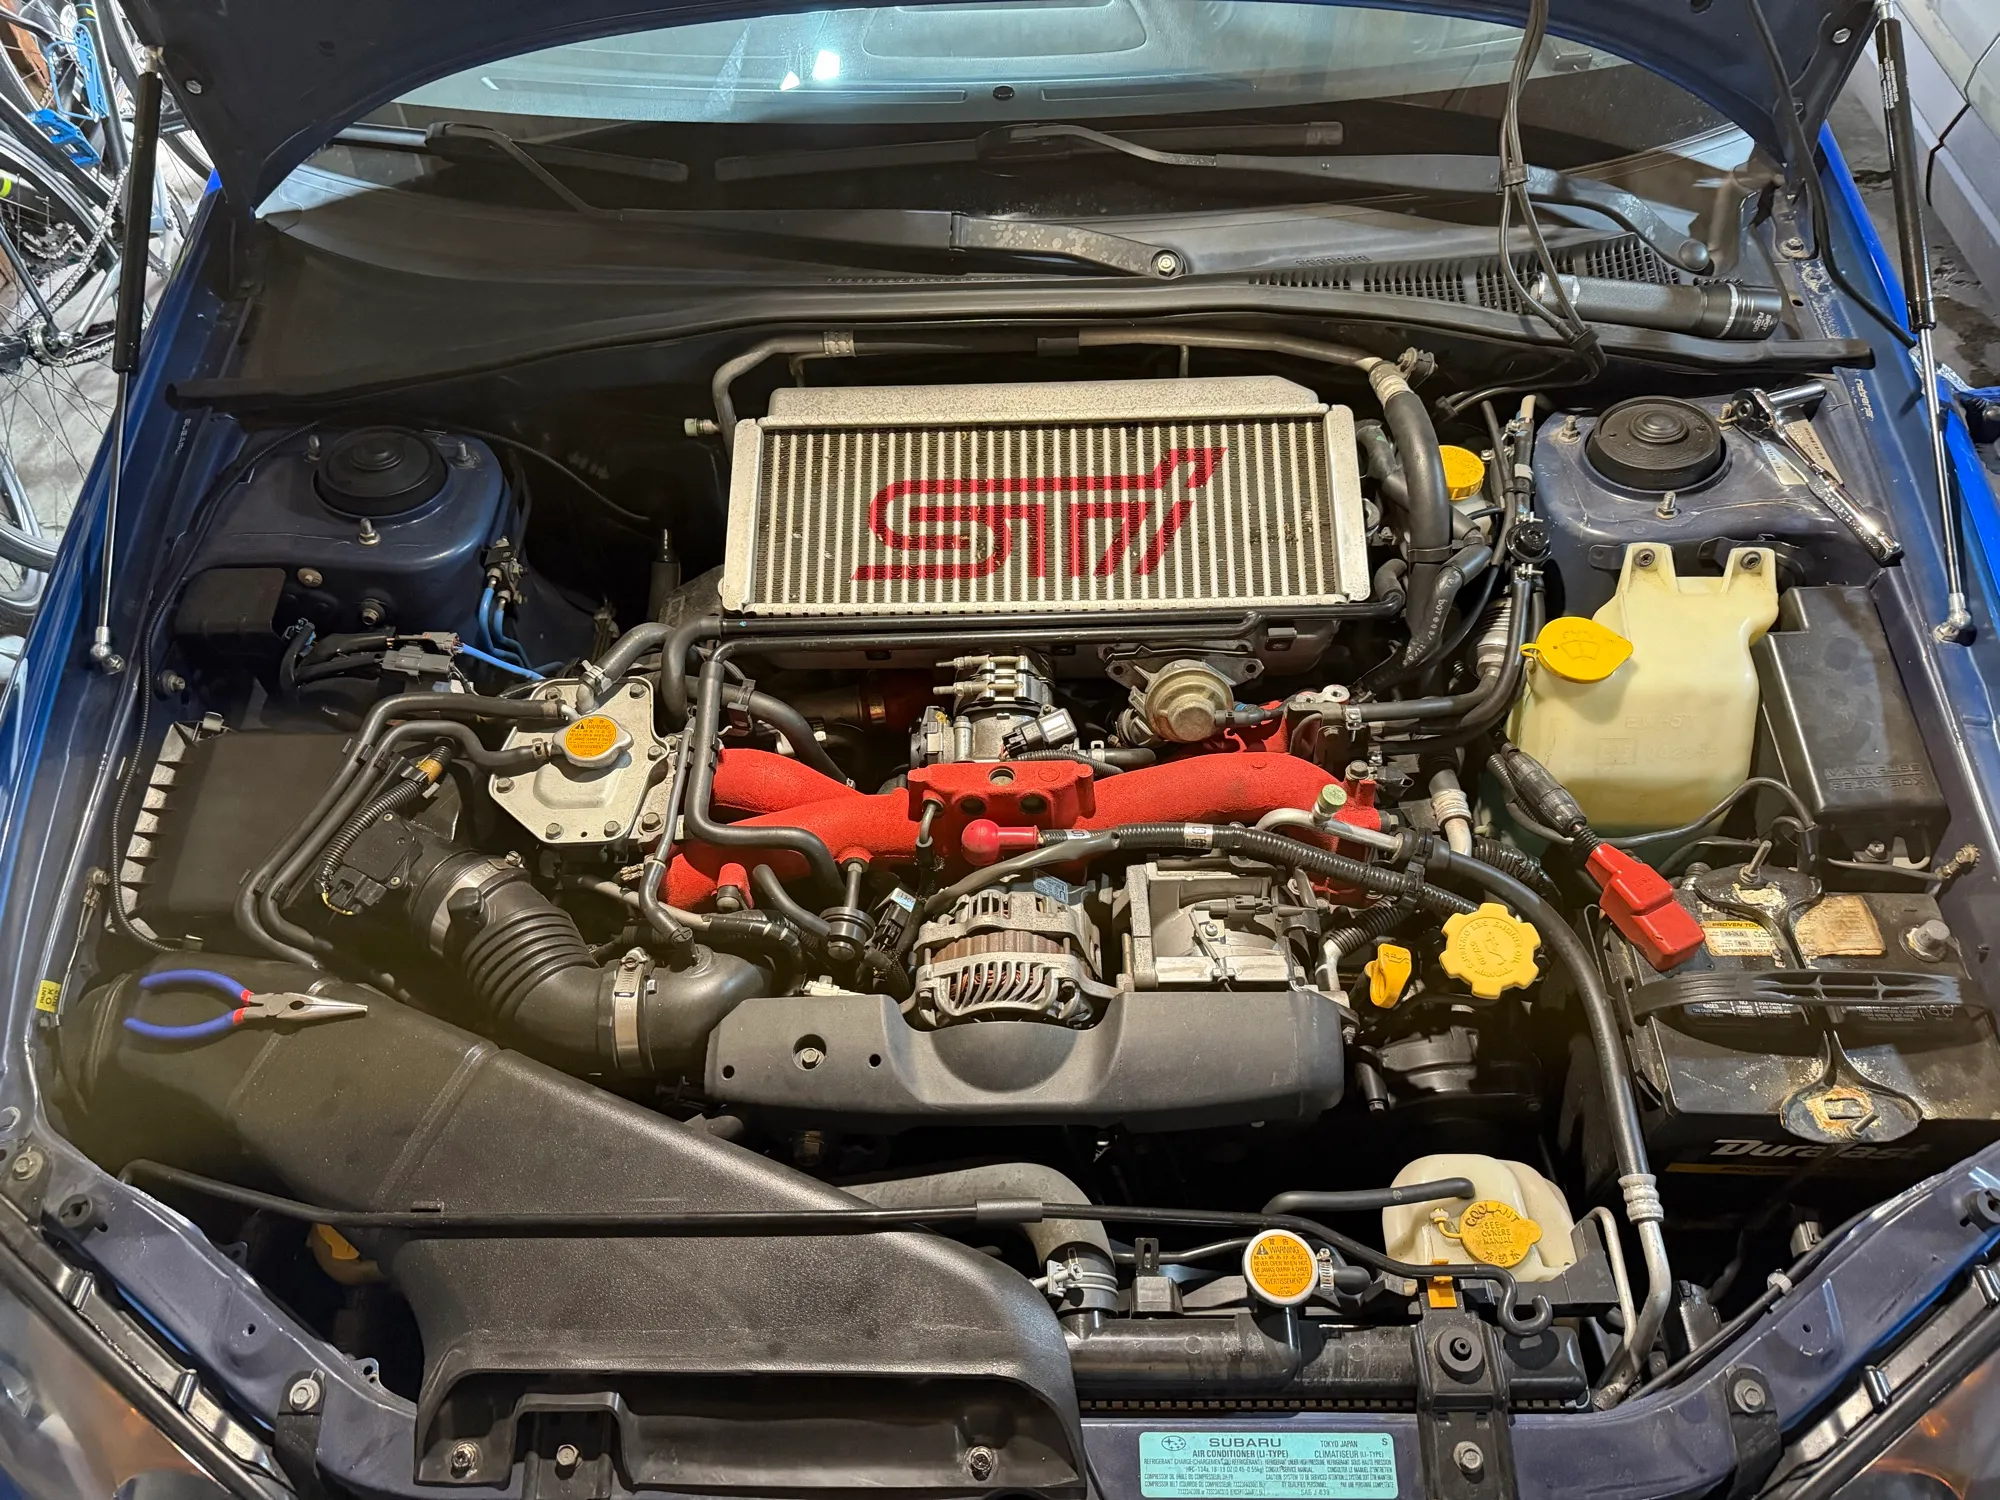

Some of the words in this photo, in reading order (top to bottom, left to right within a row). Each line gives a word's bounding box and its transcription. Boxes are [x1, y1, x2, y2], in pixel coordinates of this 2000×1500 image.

[851, 447, 1227, 581] STI
[1824, 766, 1873, 777] MAIN
[1829, 779, 1882, 790] RELAY
[1889, 777, 1926, 787] BOX
[1465, 1203, 1521, 1227] COOLANT
[1484, 1221, 1500, 1230] SEE
[1484, 1237, 1513, 1245] MANUAL
[1269, 1245, 1300, 1254] WARNING
[1209, 1438, 1281, 1448] SUBARU
[1320, 1440, 1339, 1448] TOKYO
[1340, 1440, 1358, 1448] JAPAN
[1381, 1438, 1388, 1446] S
[1192, 1450, 1206, 1458] AIR
[1206, 1450, 1255, 1458] CONDITIONER
[1314, 1450, 1359, 1459] CLIMATISEUR
